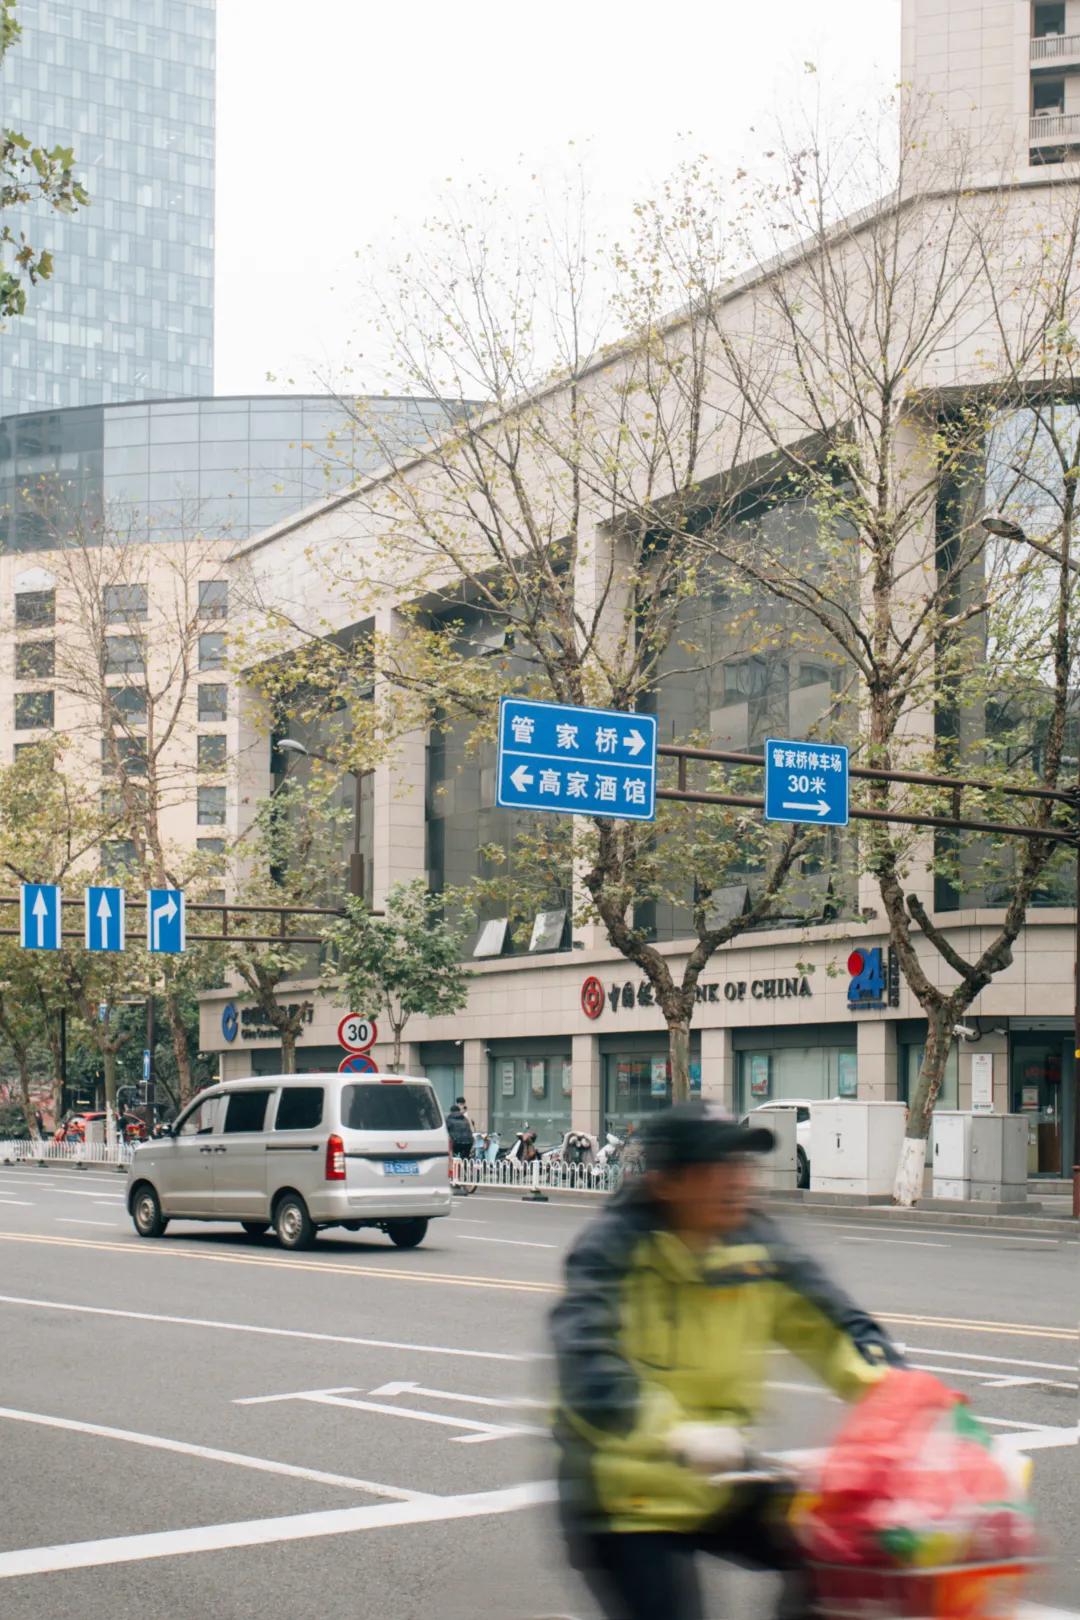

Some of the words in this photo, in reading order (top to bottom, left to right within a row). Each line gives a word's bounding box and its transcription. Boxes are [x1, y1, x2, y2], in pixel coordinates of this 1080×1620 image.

[512, 715, 619, 754] 管家桥
[773, 747, 842, 773] 管家桥停车场
[539, 768, 647, 805] 高家酒馆
[787, 775, 826, 795] 30米
[724, 981, 747, 1001] OF
[751, 976, 812, 999] CHINA
[348, 1024, 368, 1041] 30
